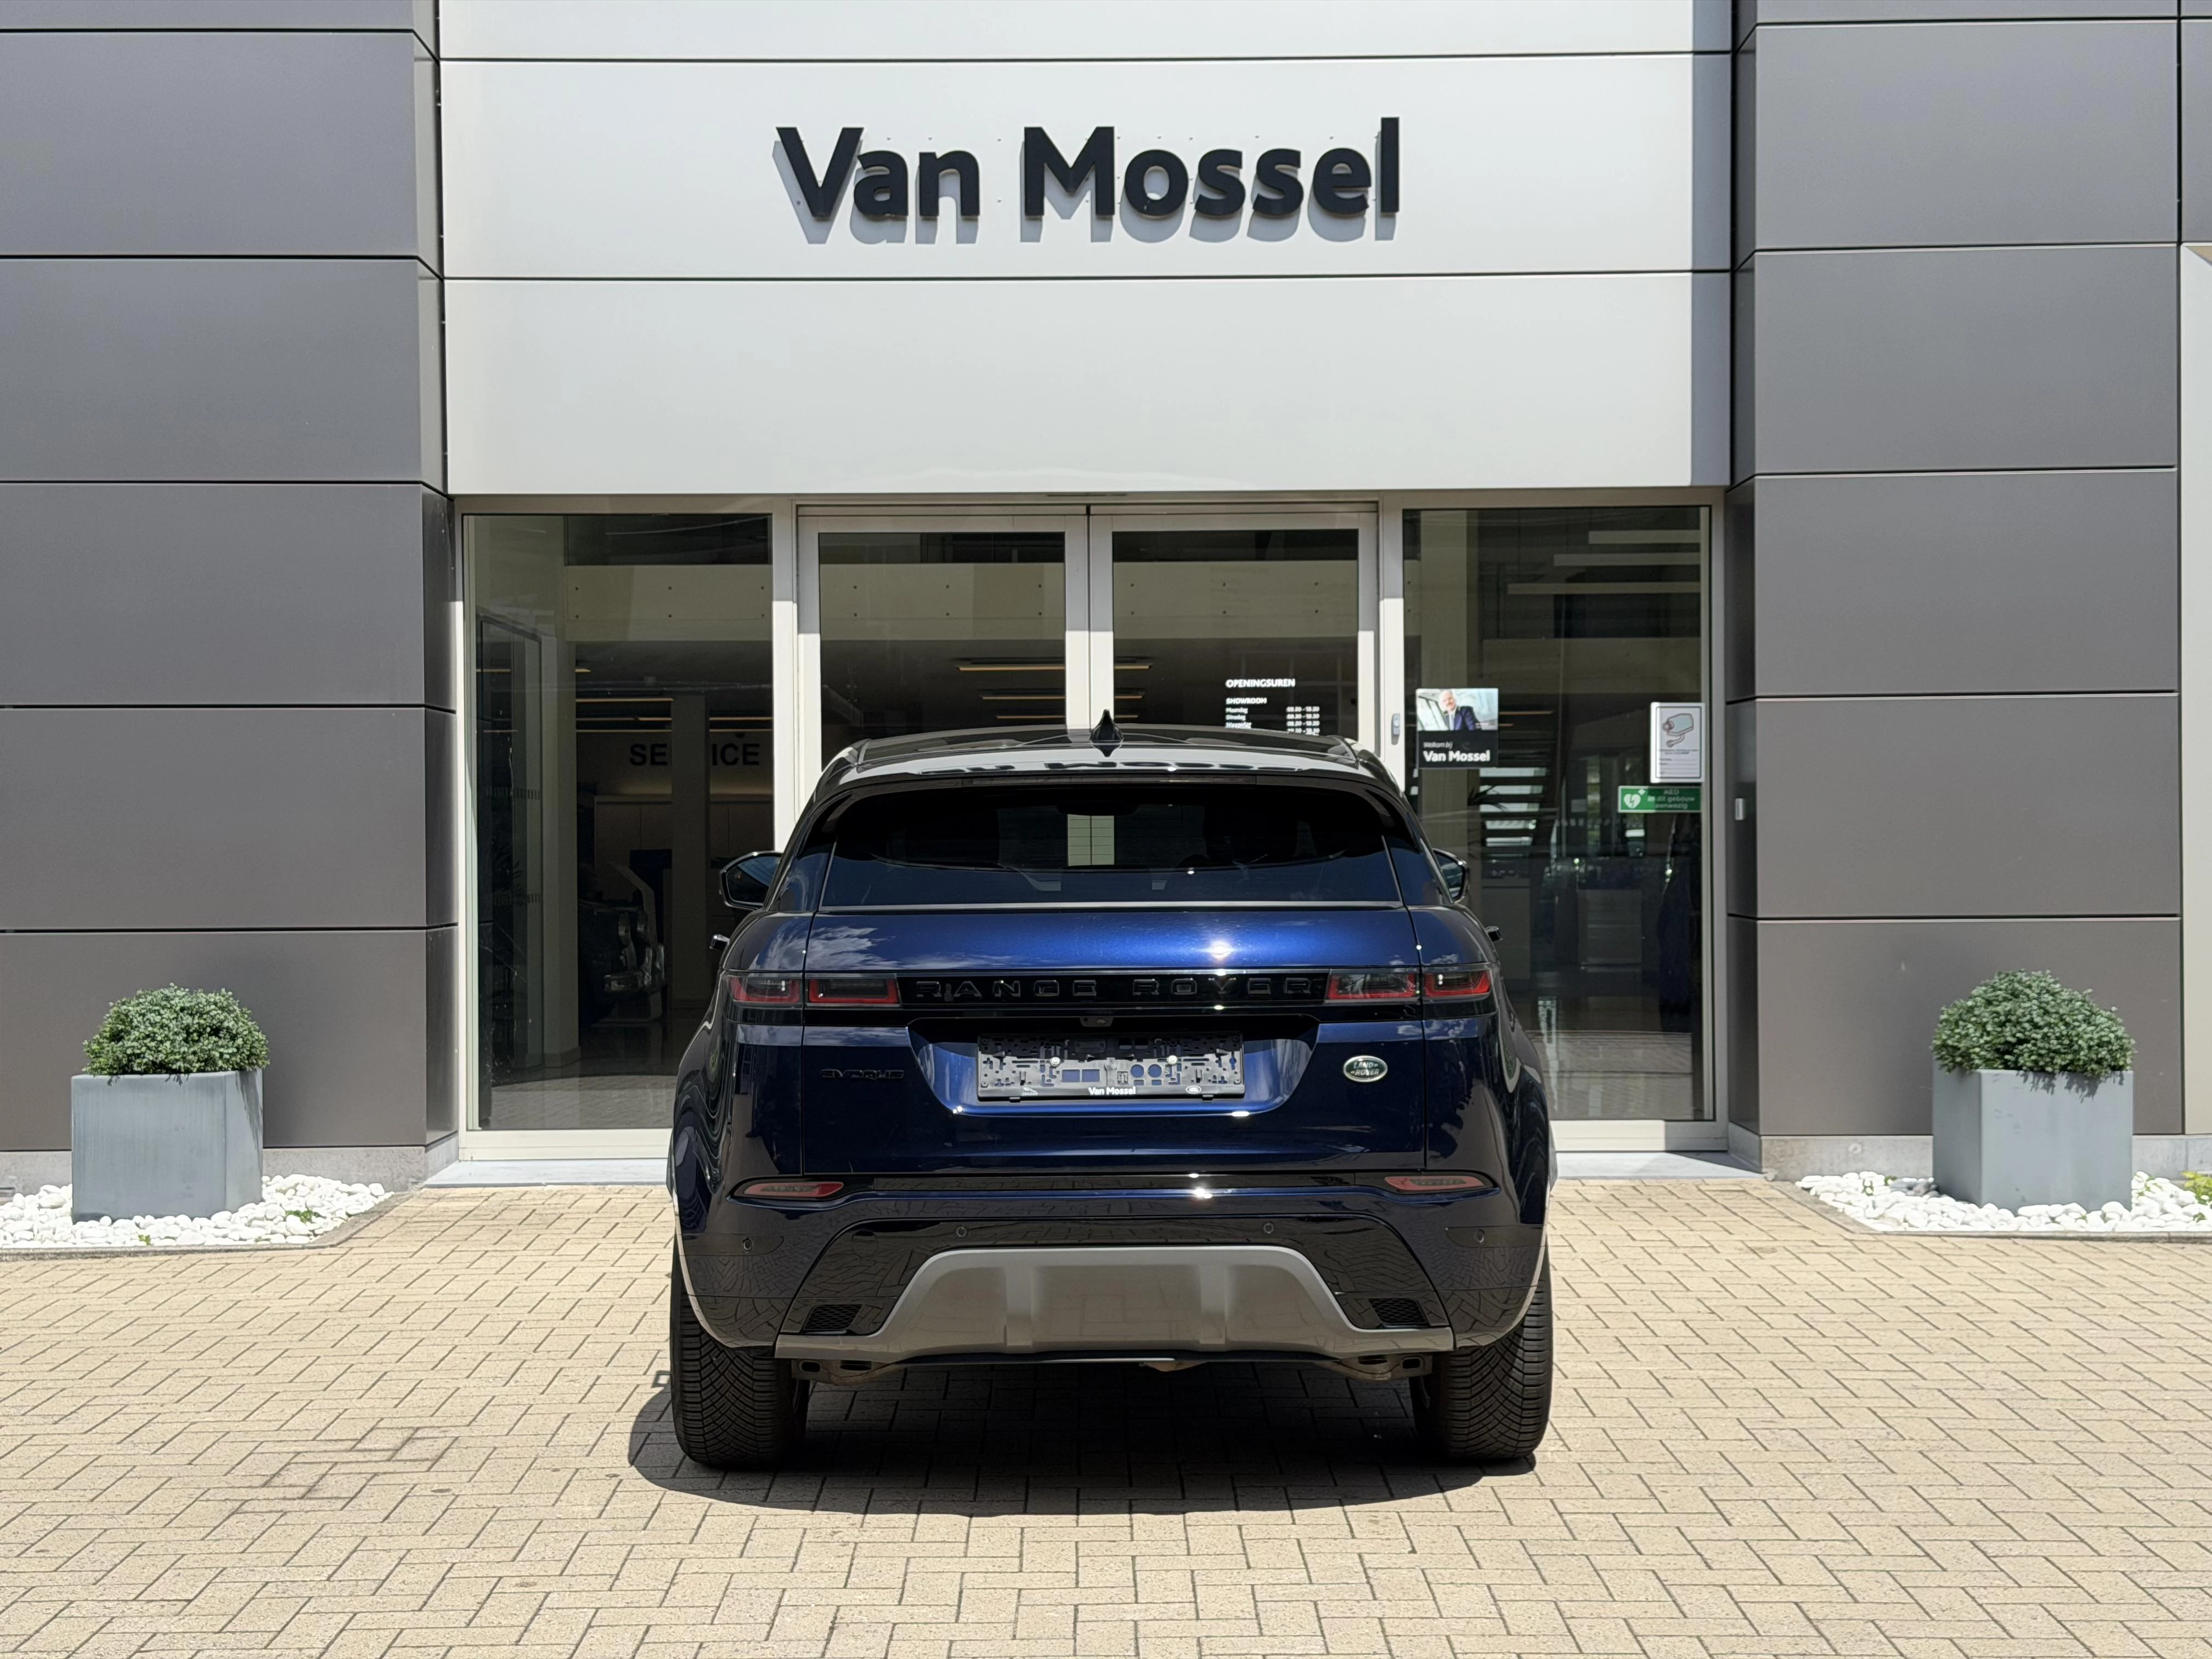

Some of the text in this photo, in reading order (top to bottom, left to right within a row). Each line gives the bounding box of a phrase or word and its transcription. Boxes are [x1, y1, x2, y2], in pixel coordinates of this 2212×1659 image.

[776, 117, 1400, 217] Van Mossel
[1226, 679, 1295, 687] OPENINGSUREN
[629, 743, 760, 766] SEICE
[1423, 749, 1491, 761] Van Mossel
[916, 978, 1312, 997] RANGE ROVER
[1106, 1086, 1136, 1094] Mossel
